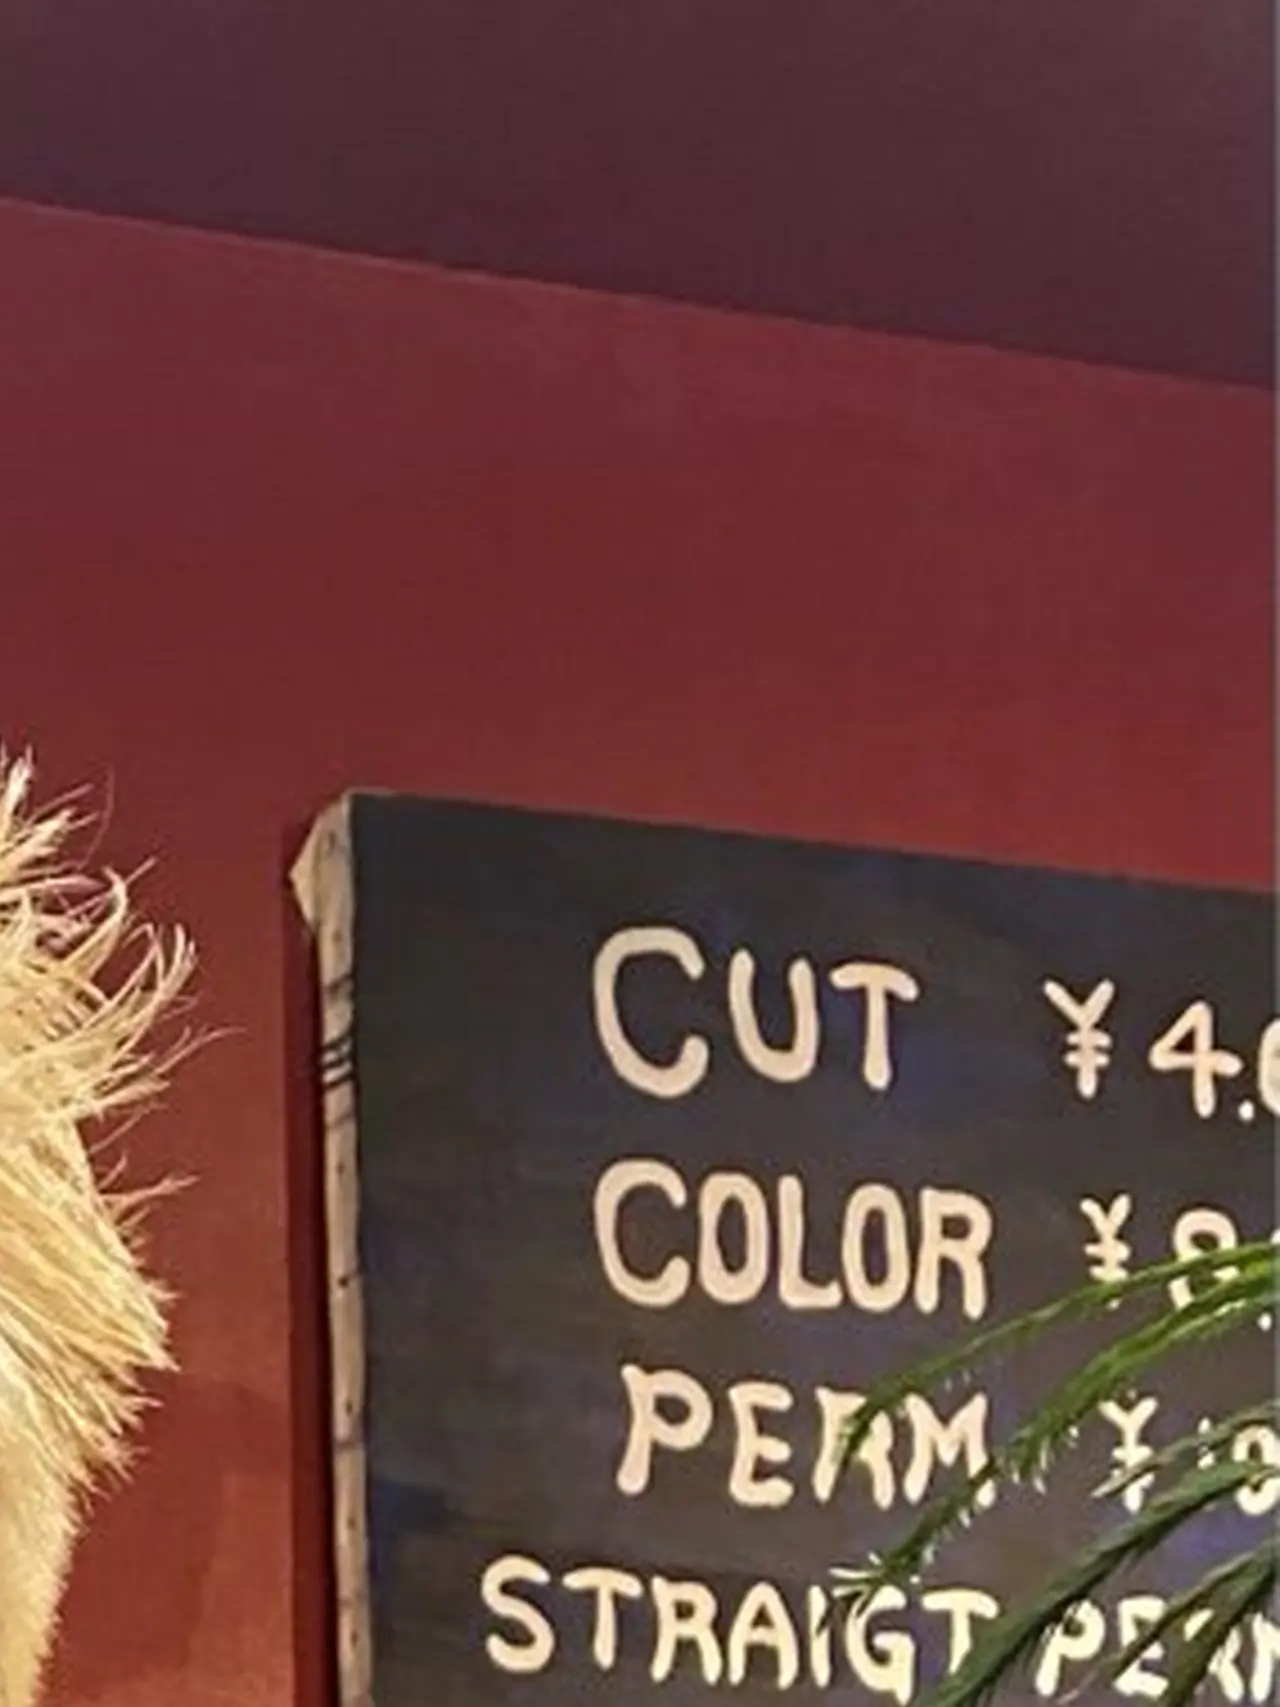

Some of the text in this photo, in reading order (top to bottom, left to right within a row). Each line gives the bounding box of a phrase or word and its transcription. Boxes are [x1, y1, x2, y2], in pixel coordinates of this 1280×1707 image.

[592, 925, 920, 1099] CUT
[594, 1157, 994, 1321] COLOR
[615, 1363, 996, 1512] PERM
